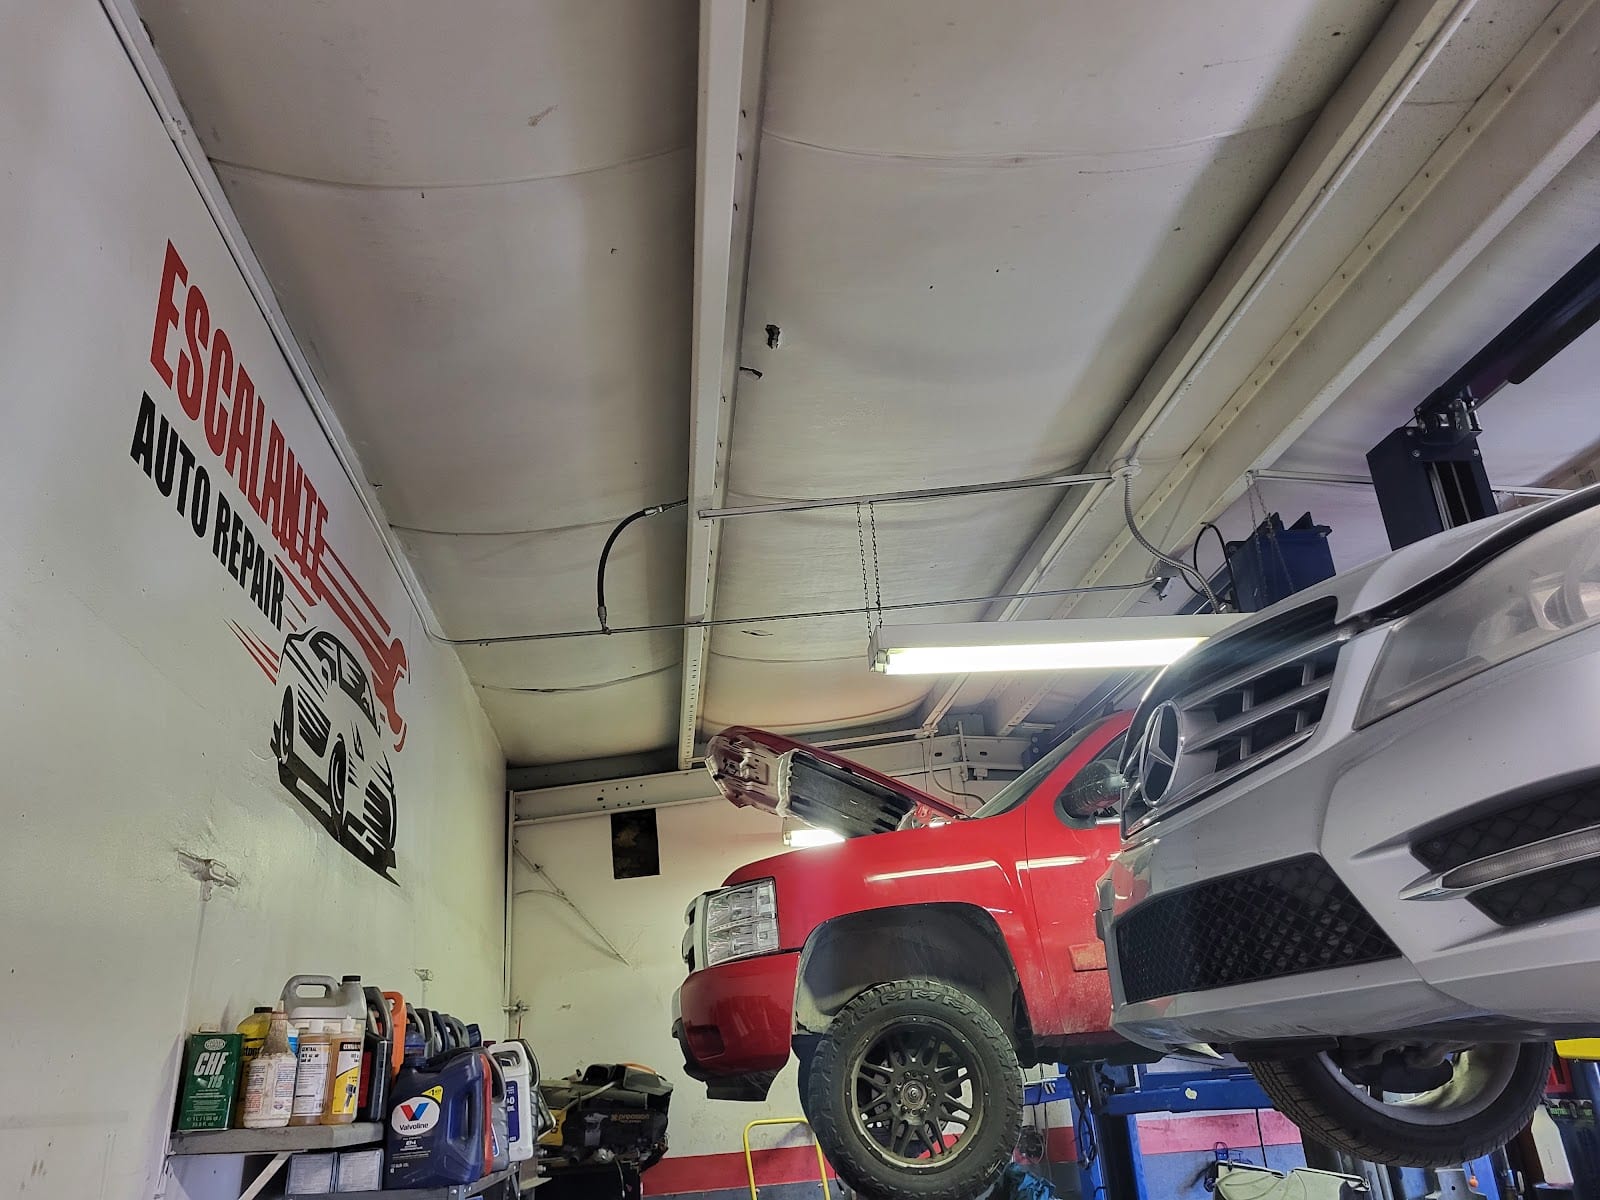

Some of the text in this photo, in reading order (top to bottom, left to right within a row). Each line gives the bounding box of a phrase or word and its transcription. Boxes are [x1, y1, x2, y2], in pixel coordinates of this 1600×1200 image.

[150, 238, 328, 577] ESCALANTE
[130, 390, 285, 632] AUTO REPAIR
[193, 1052, 230, 1076] CHF
[399, 1122, 429, 1131] Valvoline
